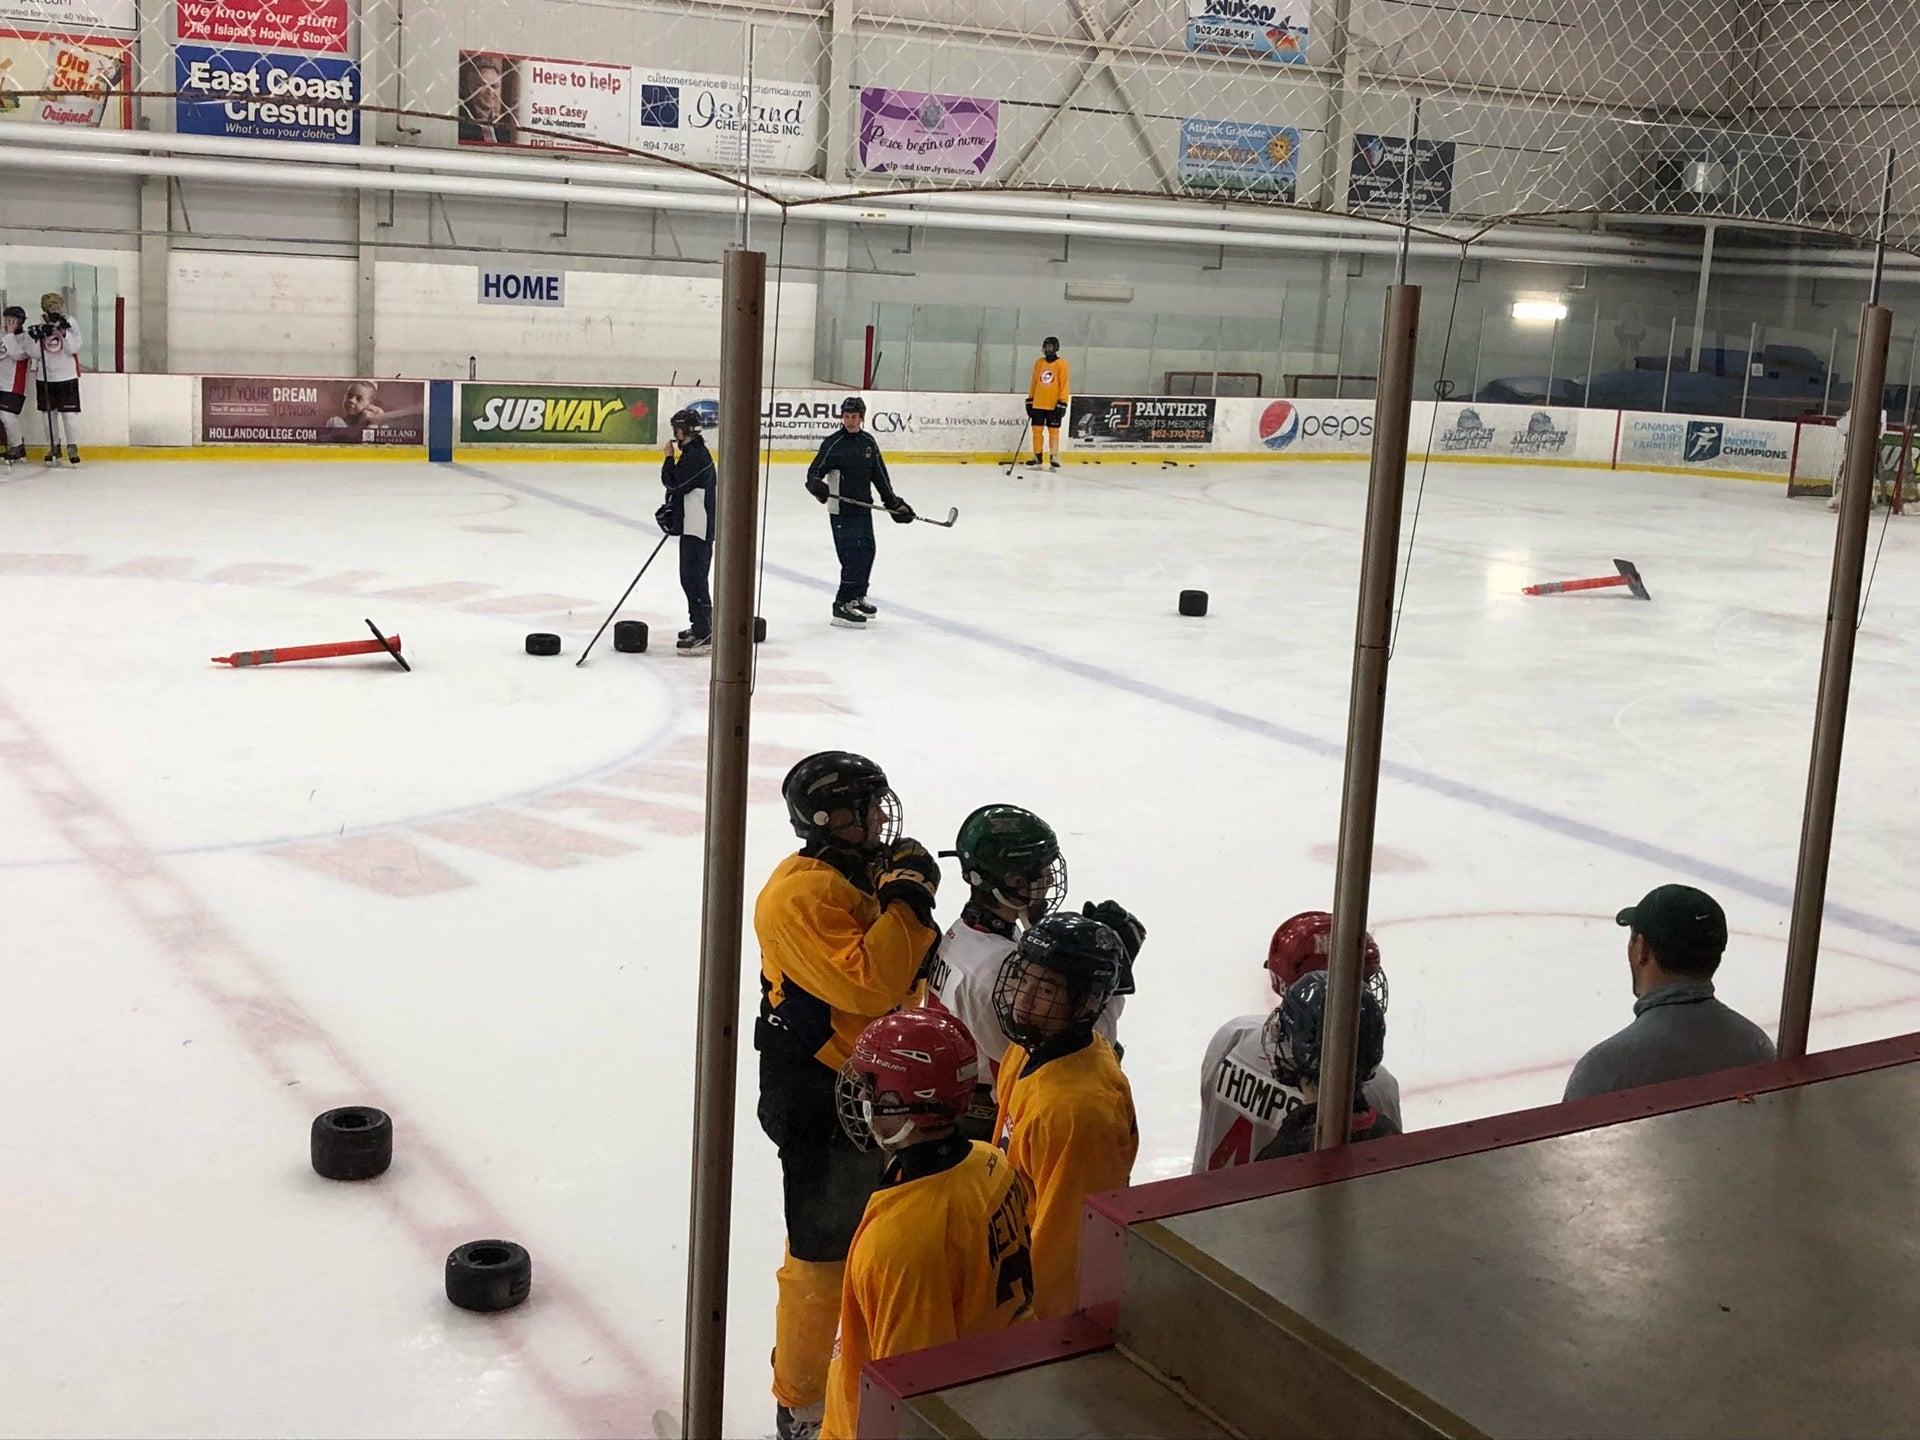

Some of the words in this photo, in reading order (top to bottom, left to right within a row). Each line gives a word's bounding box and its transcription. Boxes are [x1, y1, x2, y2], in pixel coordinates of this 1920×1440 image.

[184, 3, 210, 16] We
[216, 7, 261, 20] know
[266, 13, 292, 23] our
[297, 15, 338, 28] stuff!
[259, 28, 299, 43] Hockey
[57, 50, 89, 74] Old
[190, 61, 260, 93] East
[266, 68, 353, 100] Coast
[532, 67, 567, 85] Here
[571, 71, 586, 88] to
[590, 71, 621, 95] help
[42, 104, 94, 125] Original
[225, 99, 353, 135] Cresting
[531, 102, 557, 116] Sean
[559, 104, 588, 121] Casey
[225, 123, 260, 134] What's
[262, 127, 275, 135] on
[278, 127, 299, 139] your
[302, 129, 336, 140] clothes
[782, 124, 804, 136] INC.
[906, 138, 942, 155] begins
[484, 273, 559, 301] HOME
[237, 386, 269, 402] YOUR
[273, 387, 317, 403] DREAM
[273, 404, 286, 417] TO
[473, 398, 626, 432] SUBWAY
[761, 402, 843, 419] UBARU
[1135, 402, 1207, 417] PANTHER
[1134, 418, 1165, 428] SPORTS
[1168, 419, 1206, 429] MEDICINE
[1302, 416, 1373, 441] peps
[1634, 421, 1684, 434] CANADA'S
[209, 427, 317, 441] HOLLANDCOLLEGE.COM
[376, 429, 417, 439] HOLLAND
[1652, 432, 1683, 443] DAIRY
[1724, 437, 1767, 449] WOMEN
[1723, 446, 1787, 460] CHAMPIONS
[1027, 935, 1050, 948] CCM
